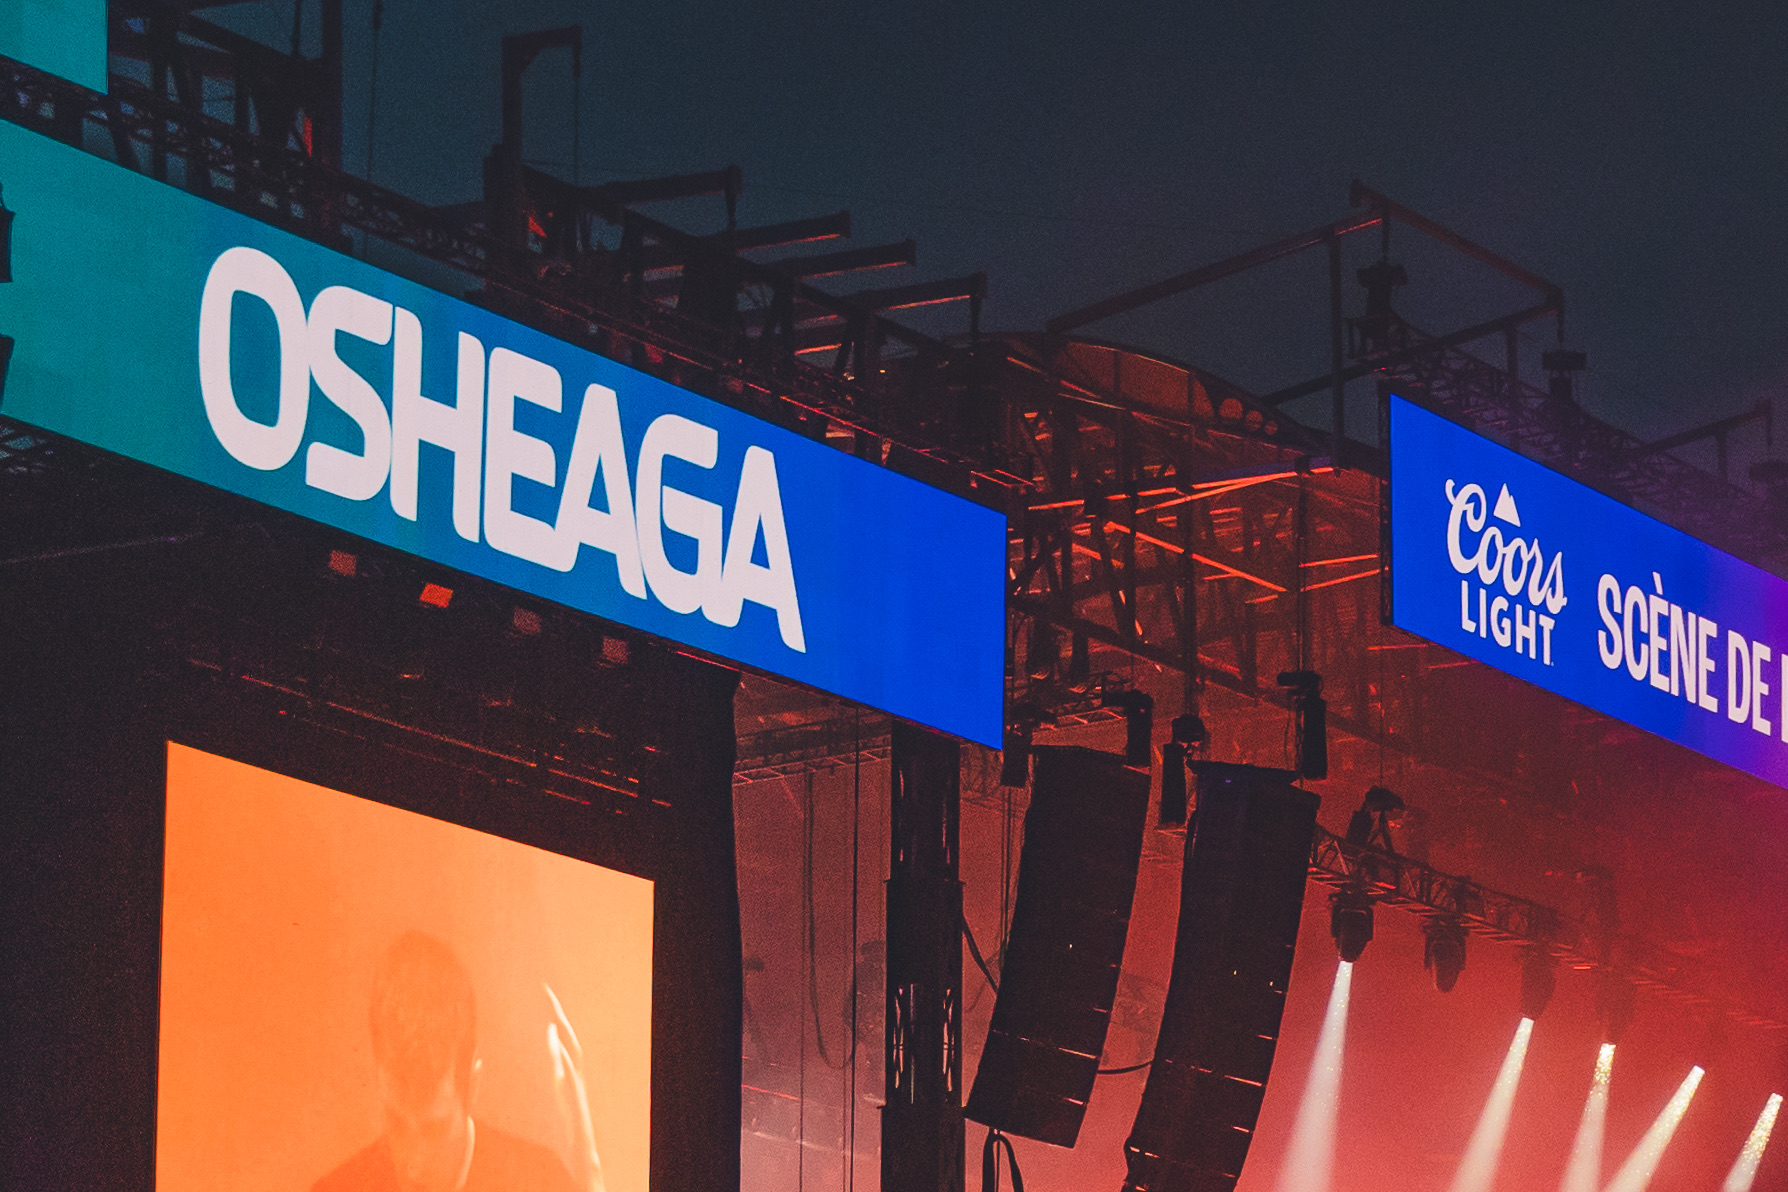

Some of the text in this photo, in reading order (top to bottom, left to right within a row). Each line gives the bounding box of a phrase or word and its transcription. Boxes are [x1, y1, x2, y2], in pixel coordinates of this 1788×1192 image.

[198, 246, 806, 653] OSHEAGA
[1444, 478, 1568, 615] Coors
[1461, 579, 1556, 666] LIGHT
[1597, 571, 1719, 713] SCÈNE
[1727, 629, 1772, 736] DE
